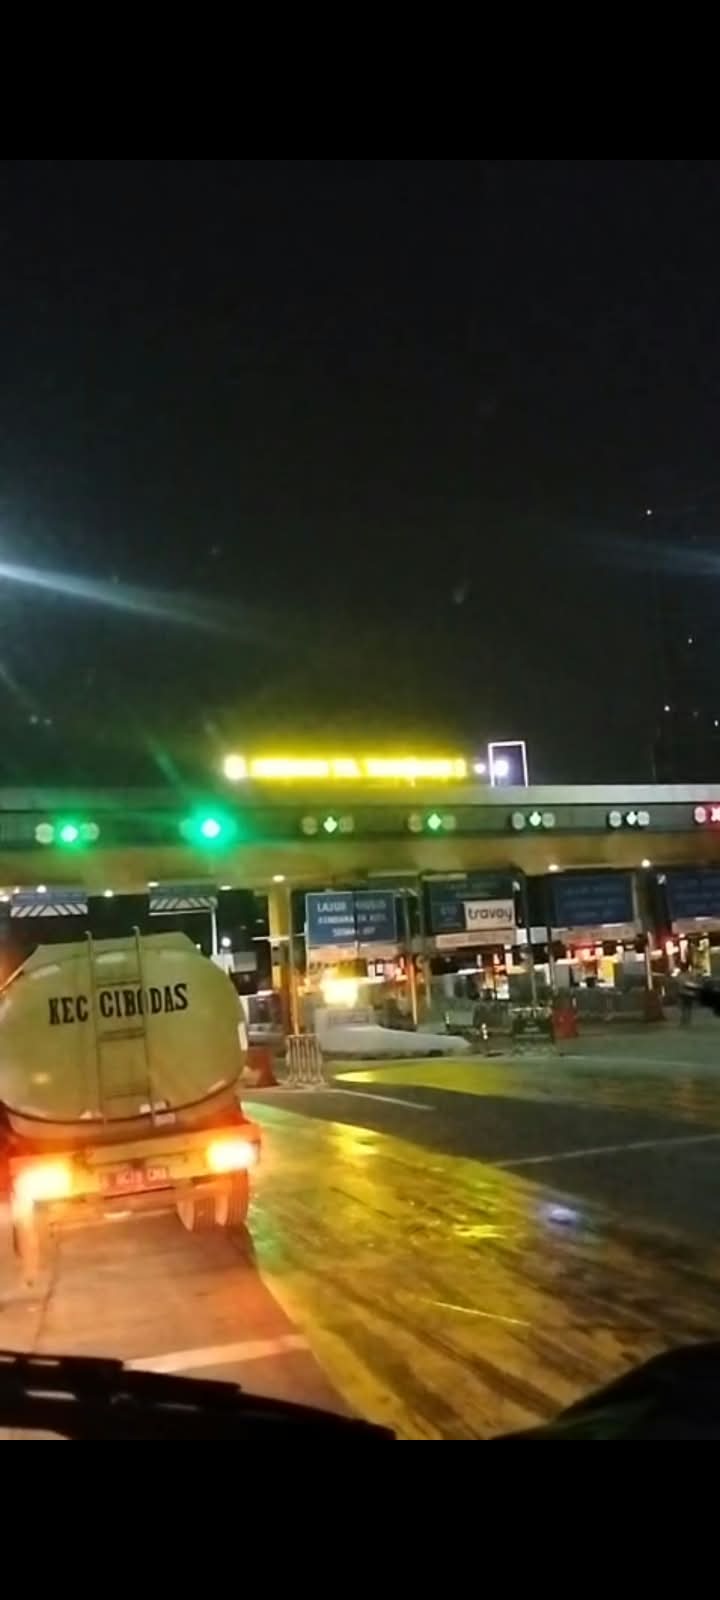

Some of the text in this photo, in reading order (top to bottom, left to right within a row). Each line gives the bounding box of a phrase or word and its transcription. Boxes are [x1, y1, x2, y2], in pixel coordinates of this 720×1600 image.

[468, 907, 513, 922] travoy
[48, 983, 188, 1025] KEC CIBODAS
